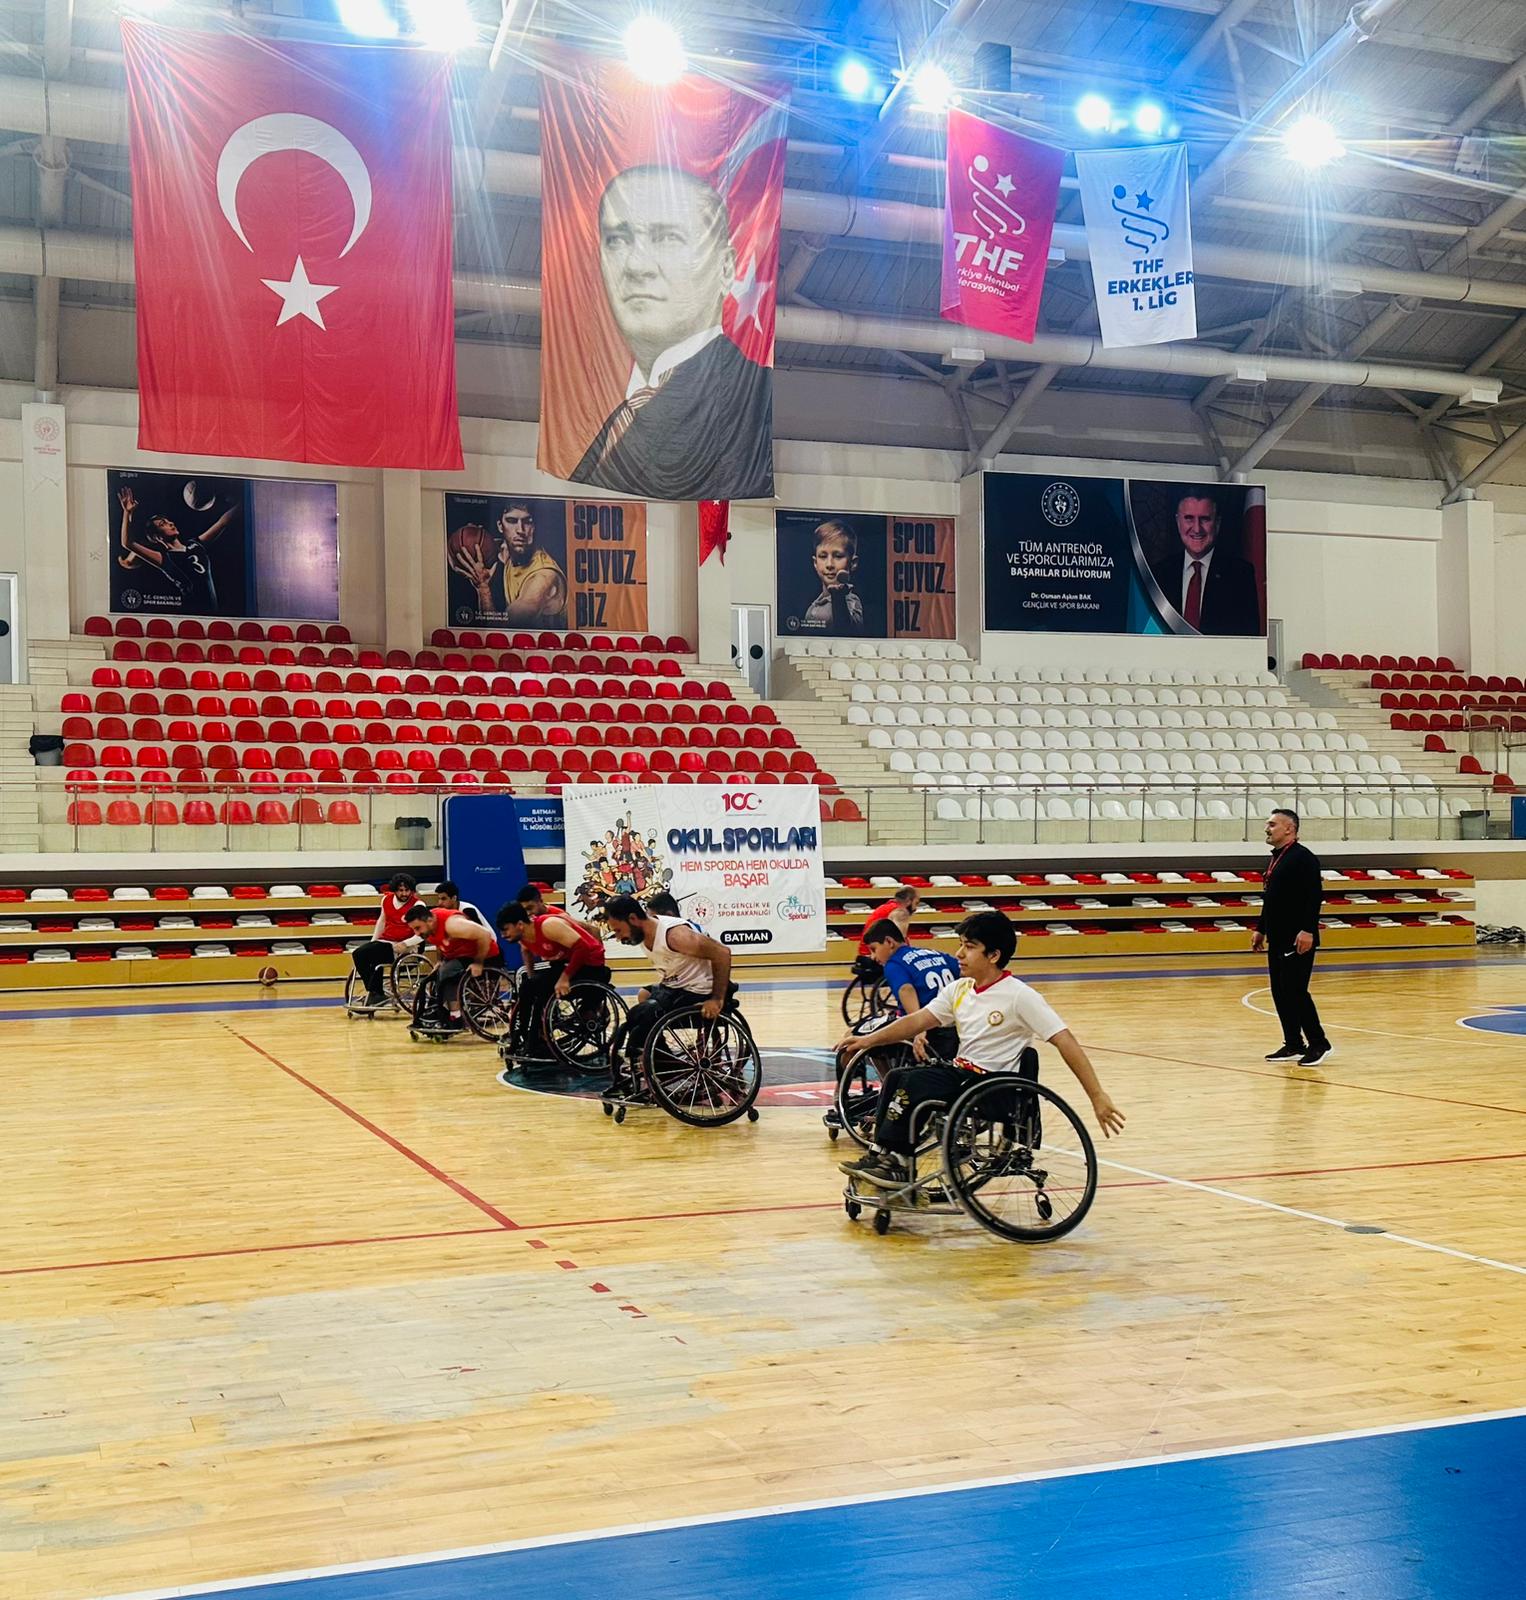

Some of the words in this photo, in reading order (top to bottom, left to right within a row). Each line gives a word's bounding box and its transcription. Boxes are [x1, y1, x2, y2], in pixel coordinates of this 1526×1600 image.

[953, 232, 1024, 276] THF
[957, 267, 983, 280] rkiye
[1132, 258, 1164, 274] THF
[1107, 270, 1194, 295] ERKEKLER
[1132, 297, 1144, 311] 1.
[1148, 290, 1178, 310] LİG
[573, 504, 624, 542] SPOR
[893, 521, 936, 555] SPOR
[1018, 540, 1044, 553] TÜM
[1045, 541, 1103, 555] ANTRENÖR
[1006, 552, 1021, 565] VE
[1022, 553, 1115, 568] SPORCULARIMIZA
[1010, 566, 1061, 579] BAŞARILAR
[1061, 567, 1112, 580] DİLİYORUM
[1030, 591, 1040, 600] Dr.
[575, 588, 608, 628] BİZ
[1022, 600, 1050, 610] GENÇLİK
[1049, 601, 1058, 609] VE
[1058, 602, 1076, 610] SPOR
[1076, 602, 1100, 611] BAKANI
[894, 596, 921, 632] BİZ
[666, 827, 722, 854] OKUL
[722, 826, 817, 853] SPORLARI
[680, 860, 703, 872] HEM
[703, 860, 745, 872] SPORDA
[746, 860, 768, 871] HEM
[769, 859, 810, 870] OKULDA
[723, 872, 770, 889] BAŞARI
[717, 910, 736, 918] SPOR
[736, 908, 771, 917] BAKANLIĞI
[730, 901, 760, 910] GENÇLİK
[723, 931, 769, 943] BATMAN
